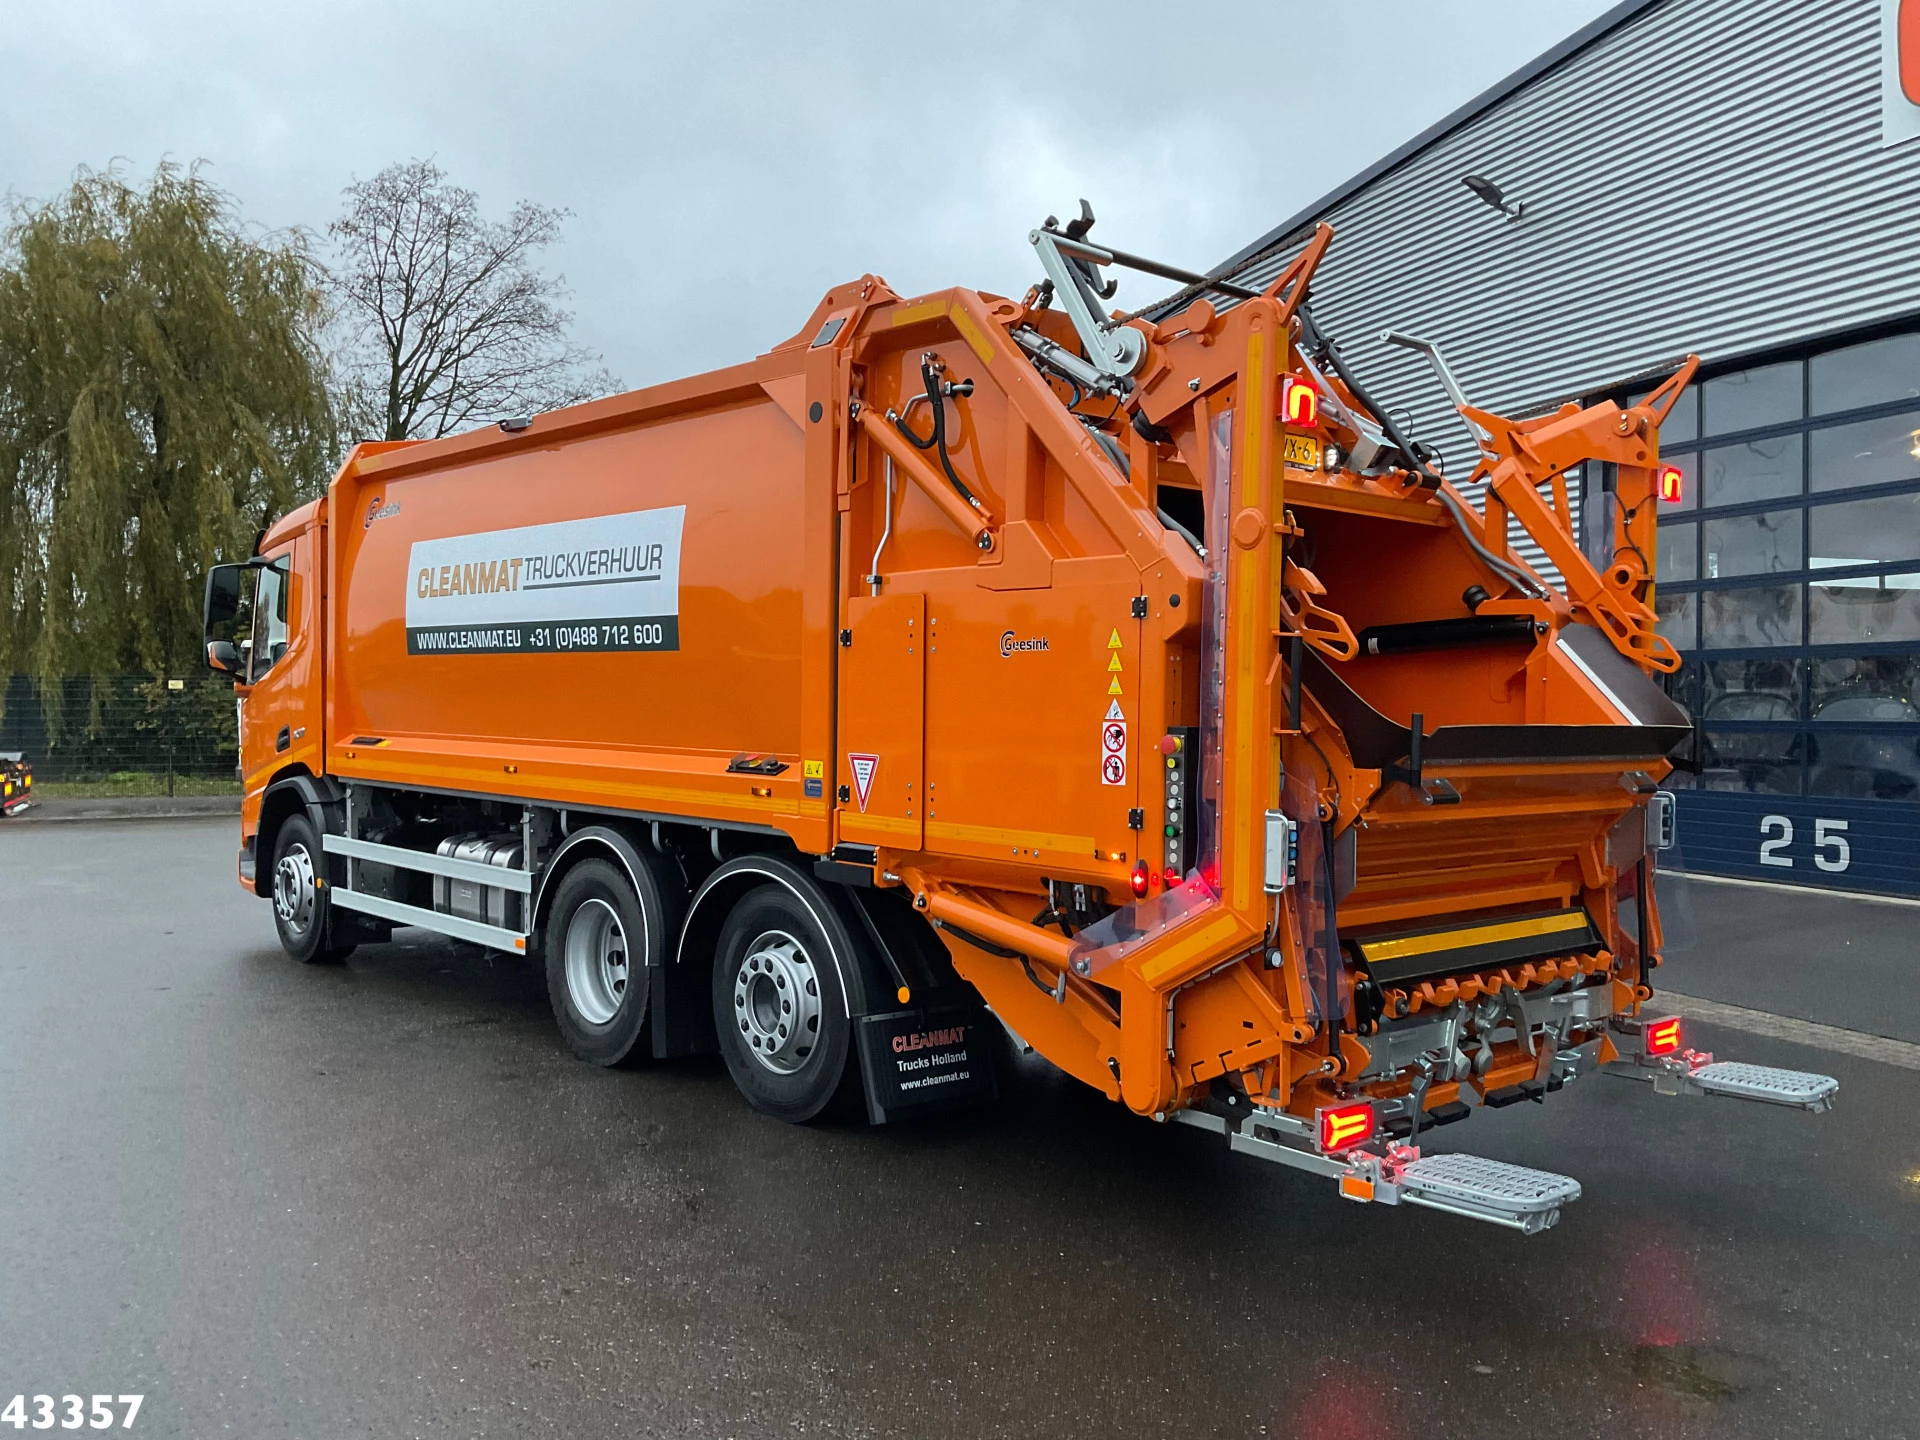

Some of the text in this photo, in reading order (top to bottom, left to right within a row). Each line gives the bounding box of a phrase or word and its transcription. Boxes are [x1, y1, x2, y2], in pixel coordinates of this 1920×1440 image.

[417, 544, 662, 598] CLEANMAT TRUCKVERHUUR
[417, 624, 662, 649] WWW.CLEANMAT.EU +31 (0)488 712 600
[1001, 632, 1049, 655] Geesink
[892, 1027, 965, 1053] CLEANMAT
[897, 1050, 967, 1072] Trucks Holland
[900, 1070, 969, 1091] www.cleanmat.eu
